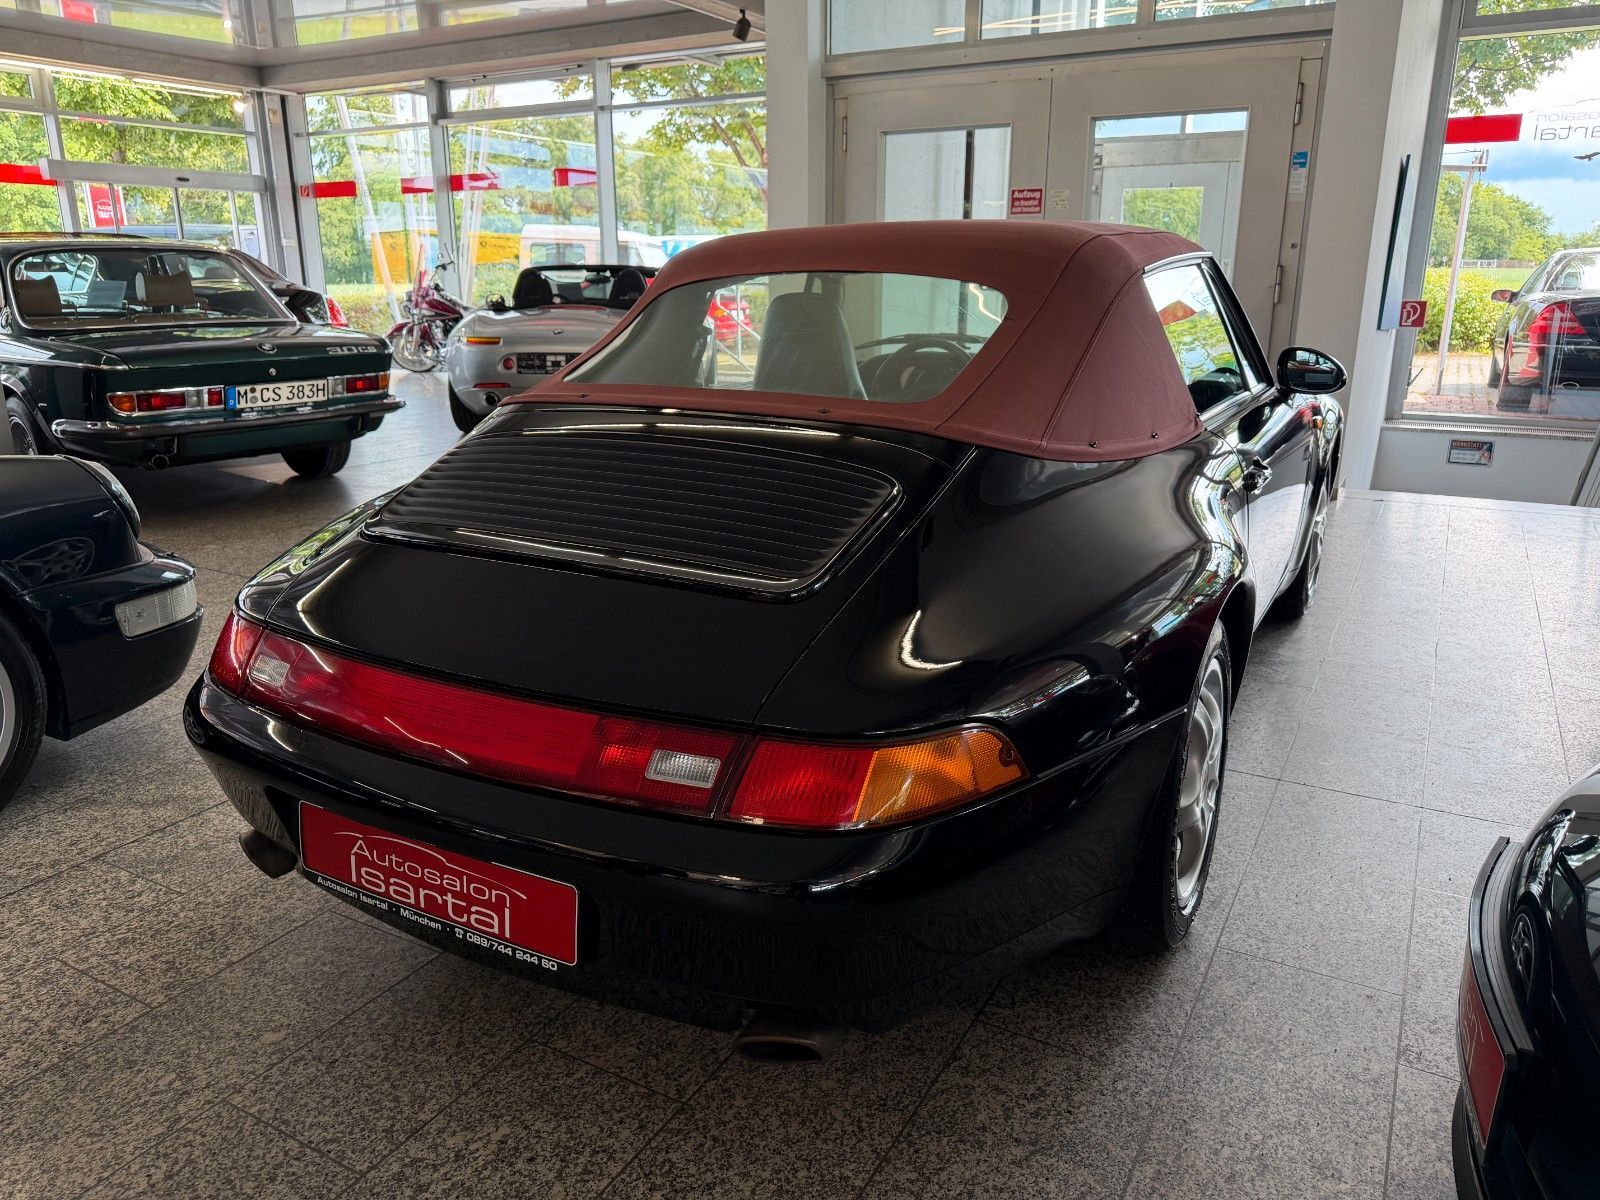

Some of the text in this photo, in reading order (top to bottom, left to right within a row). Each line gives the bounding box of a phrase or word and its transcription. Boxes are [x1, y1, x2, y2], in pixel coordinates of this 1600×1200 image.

[237, 383, 325, 404] M CS 383H
[350, 839, 510, 908] Autosalon
[350, 854, 511, 938] Isartal
[317, 876, 558, 971] Autosalon Isartal München 089/744 244 60
